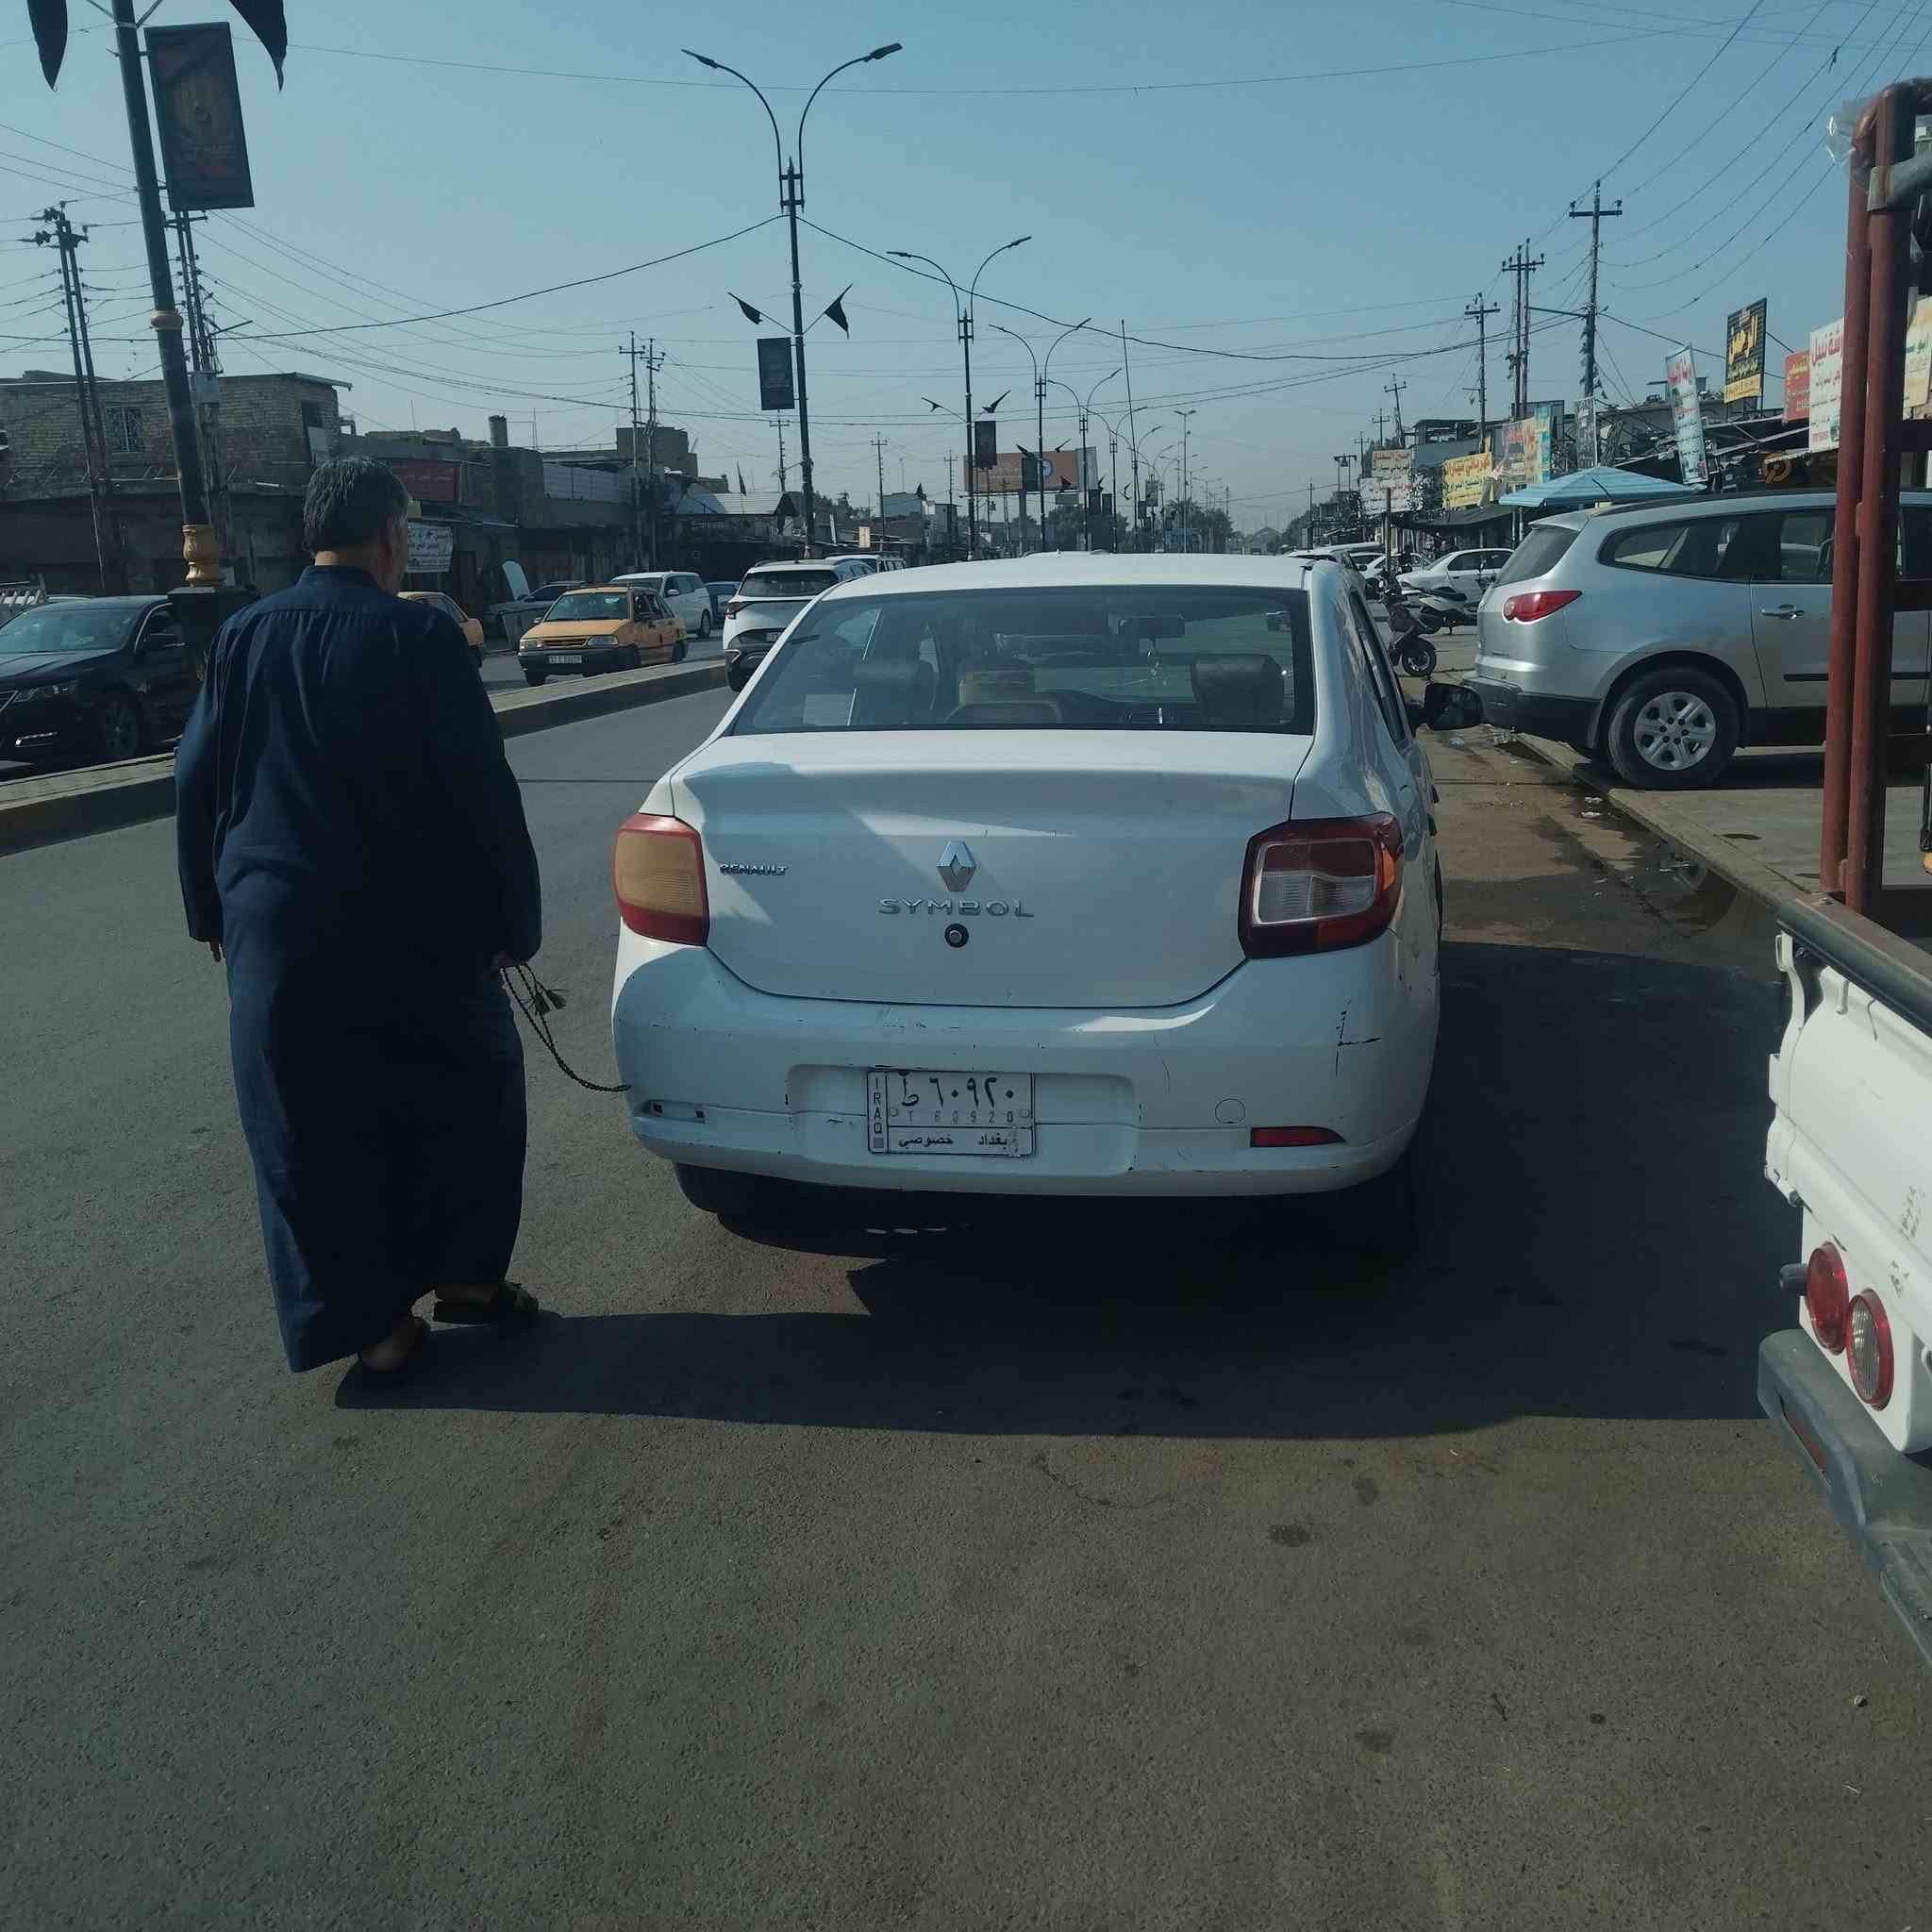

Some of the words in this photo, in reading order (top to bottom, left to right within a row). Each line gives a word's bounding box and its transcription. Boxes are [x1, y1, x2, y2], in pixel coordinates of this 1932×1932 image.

[719, 862, 788, 876] RENAULT
[877, 897, 1035, 919] SYMBOL
[898, 1135, 954, 1150] خصوصي
[977, 1134, 1008, 1150] بغداد
